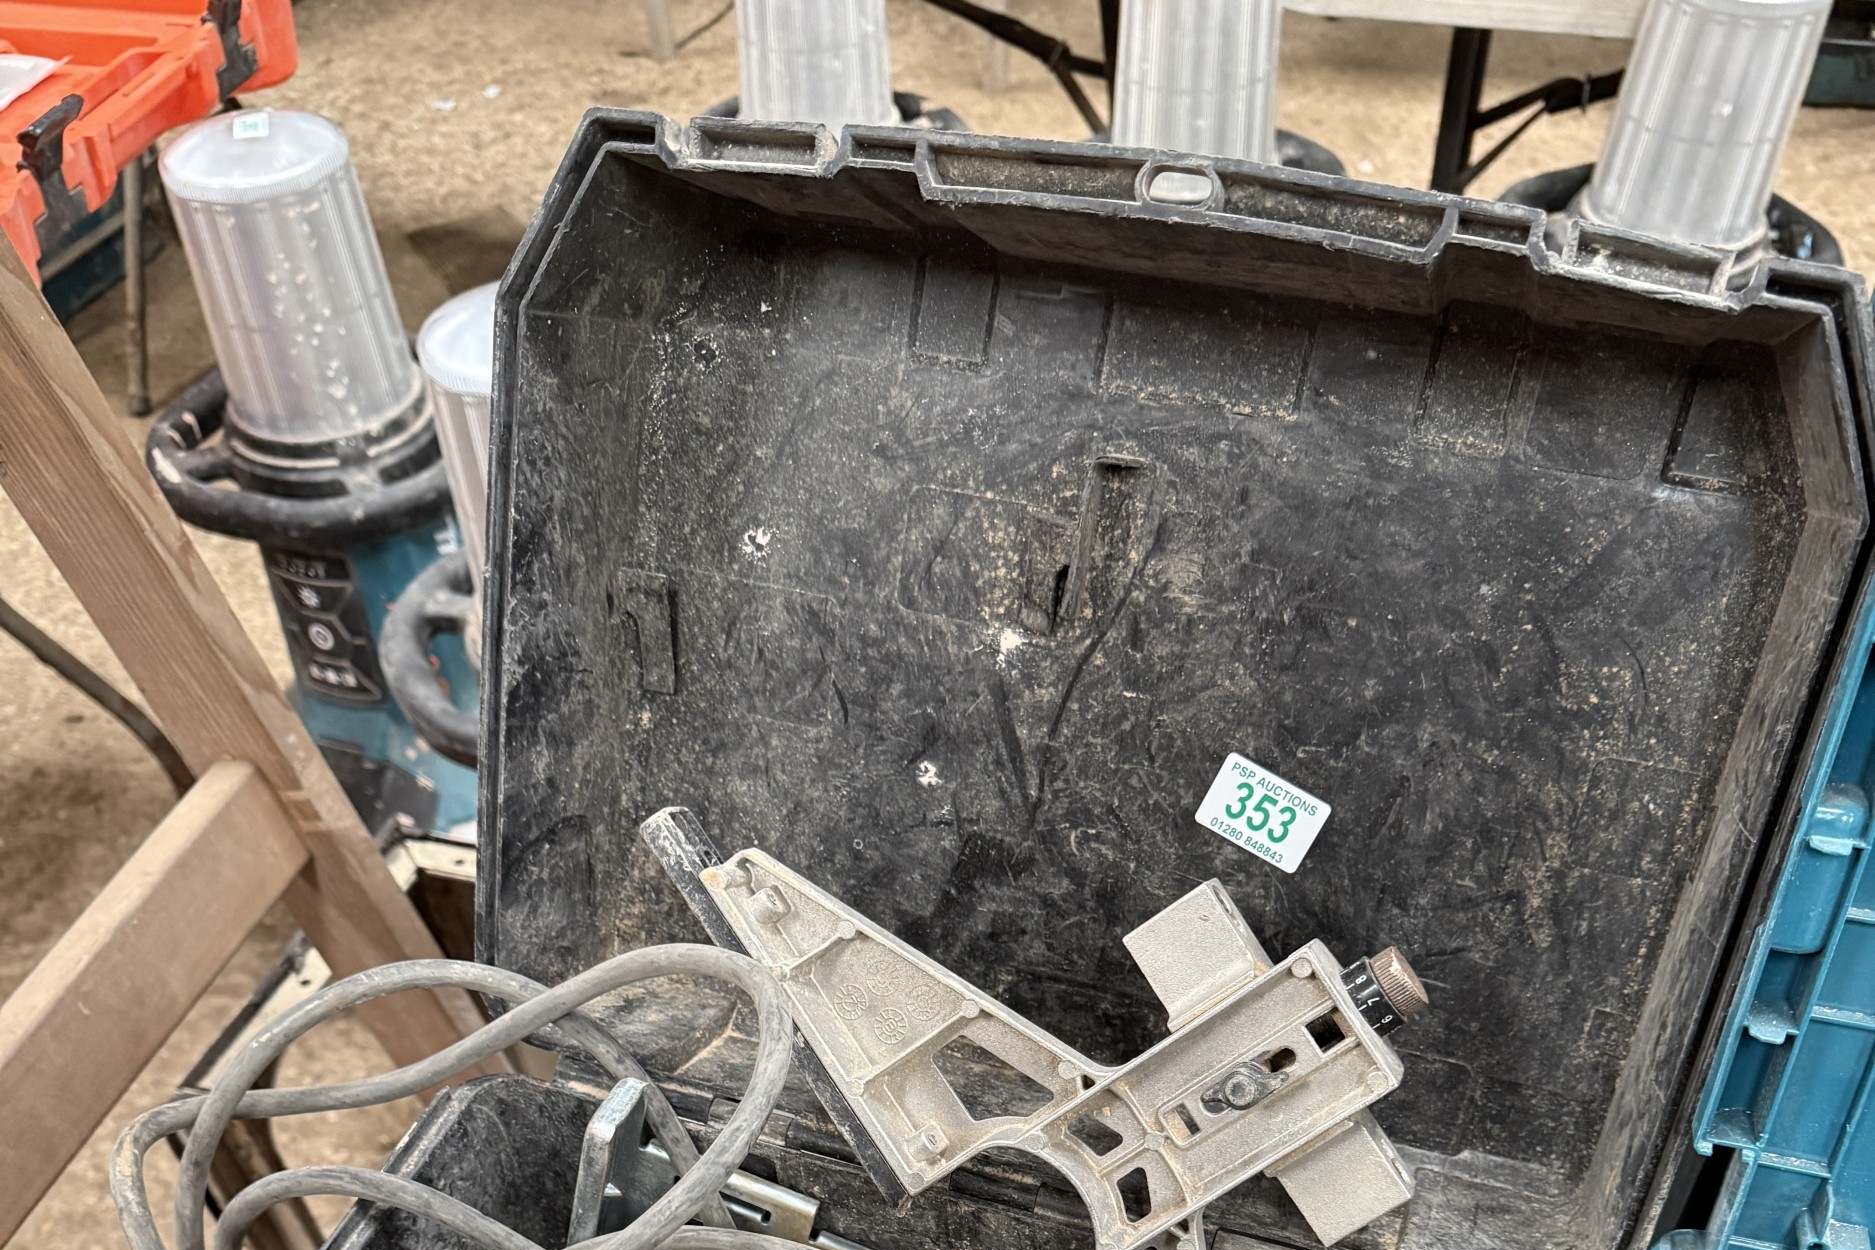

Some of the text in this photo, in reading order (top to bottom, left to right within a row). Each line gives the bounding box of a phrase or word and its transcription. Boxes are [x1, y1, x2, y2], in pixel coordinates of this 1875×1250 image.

[1225, 782, 1297, 844] 353
[1231, 762, 1318, 817] PSP AUCTIONS
[1210, 817, 1284, 864] 01280 848843
[1355, 974, 1367, 985] 8
[1367, 997, 1380, 1007] 7
